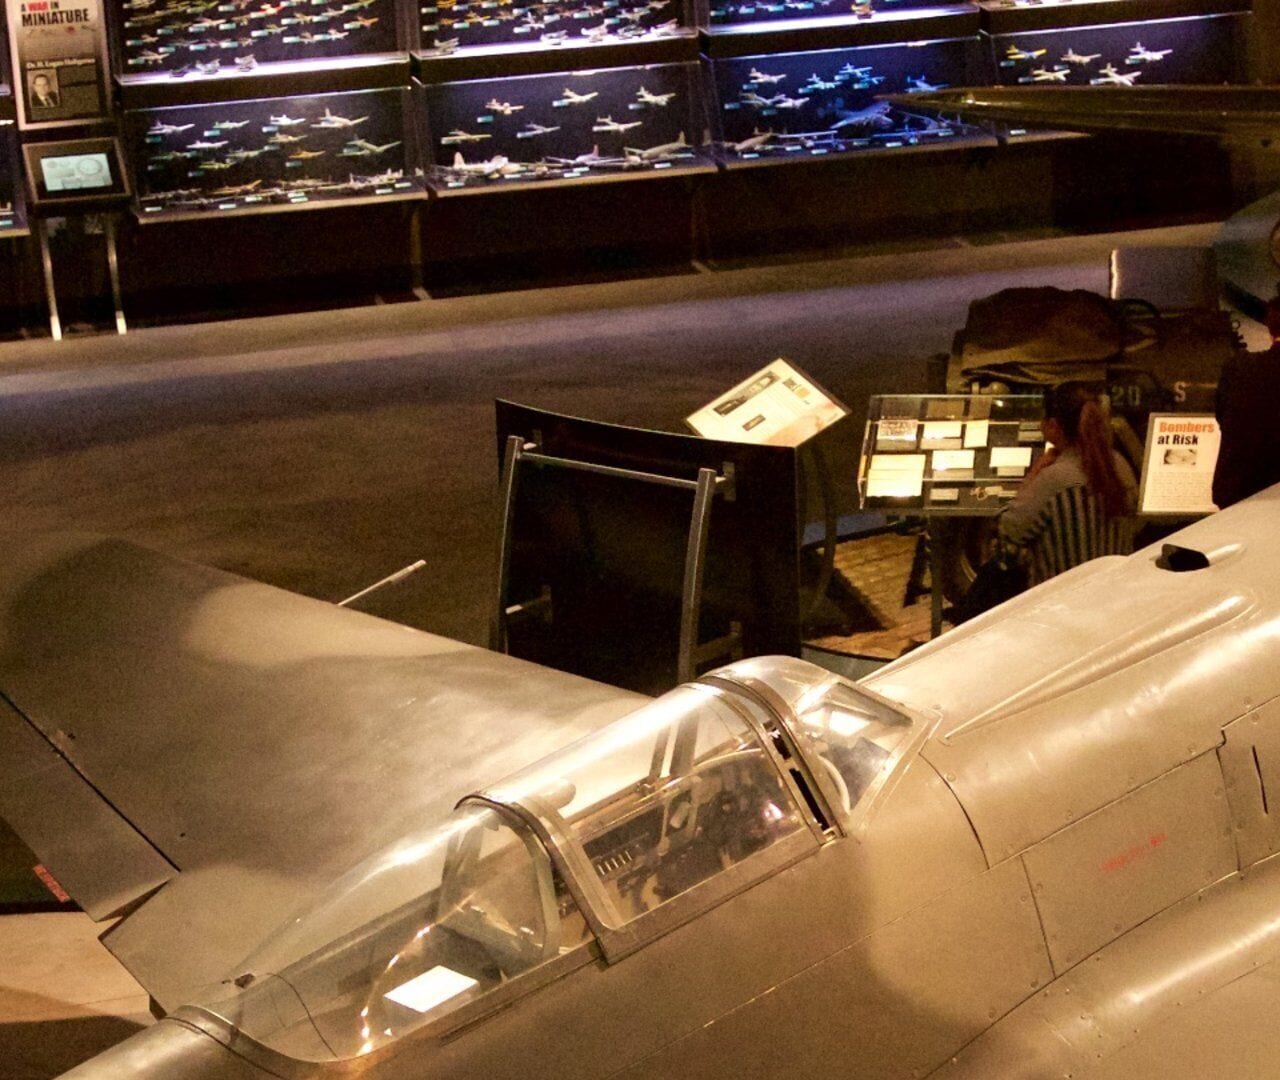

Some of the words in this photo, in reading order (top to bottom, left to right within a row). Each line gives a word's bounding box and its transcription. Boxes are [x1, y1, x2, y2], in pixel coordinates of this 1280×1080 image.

[50, 1, 59, 9] IN
[22, 8, 90, 27] MINIATURE
[1159, 421, 1215, 434] Bombers
[1157, 435, 1170, 445] at
[1172, 433, 1198, 445] Risk
